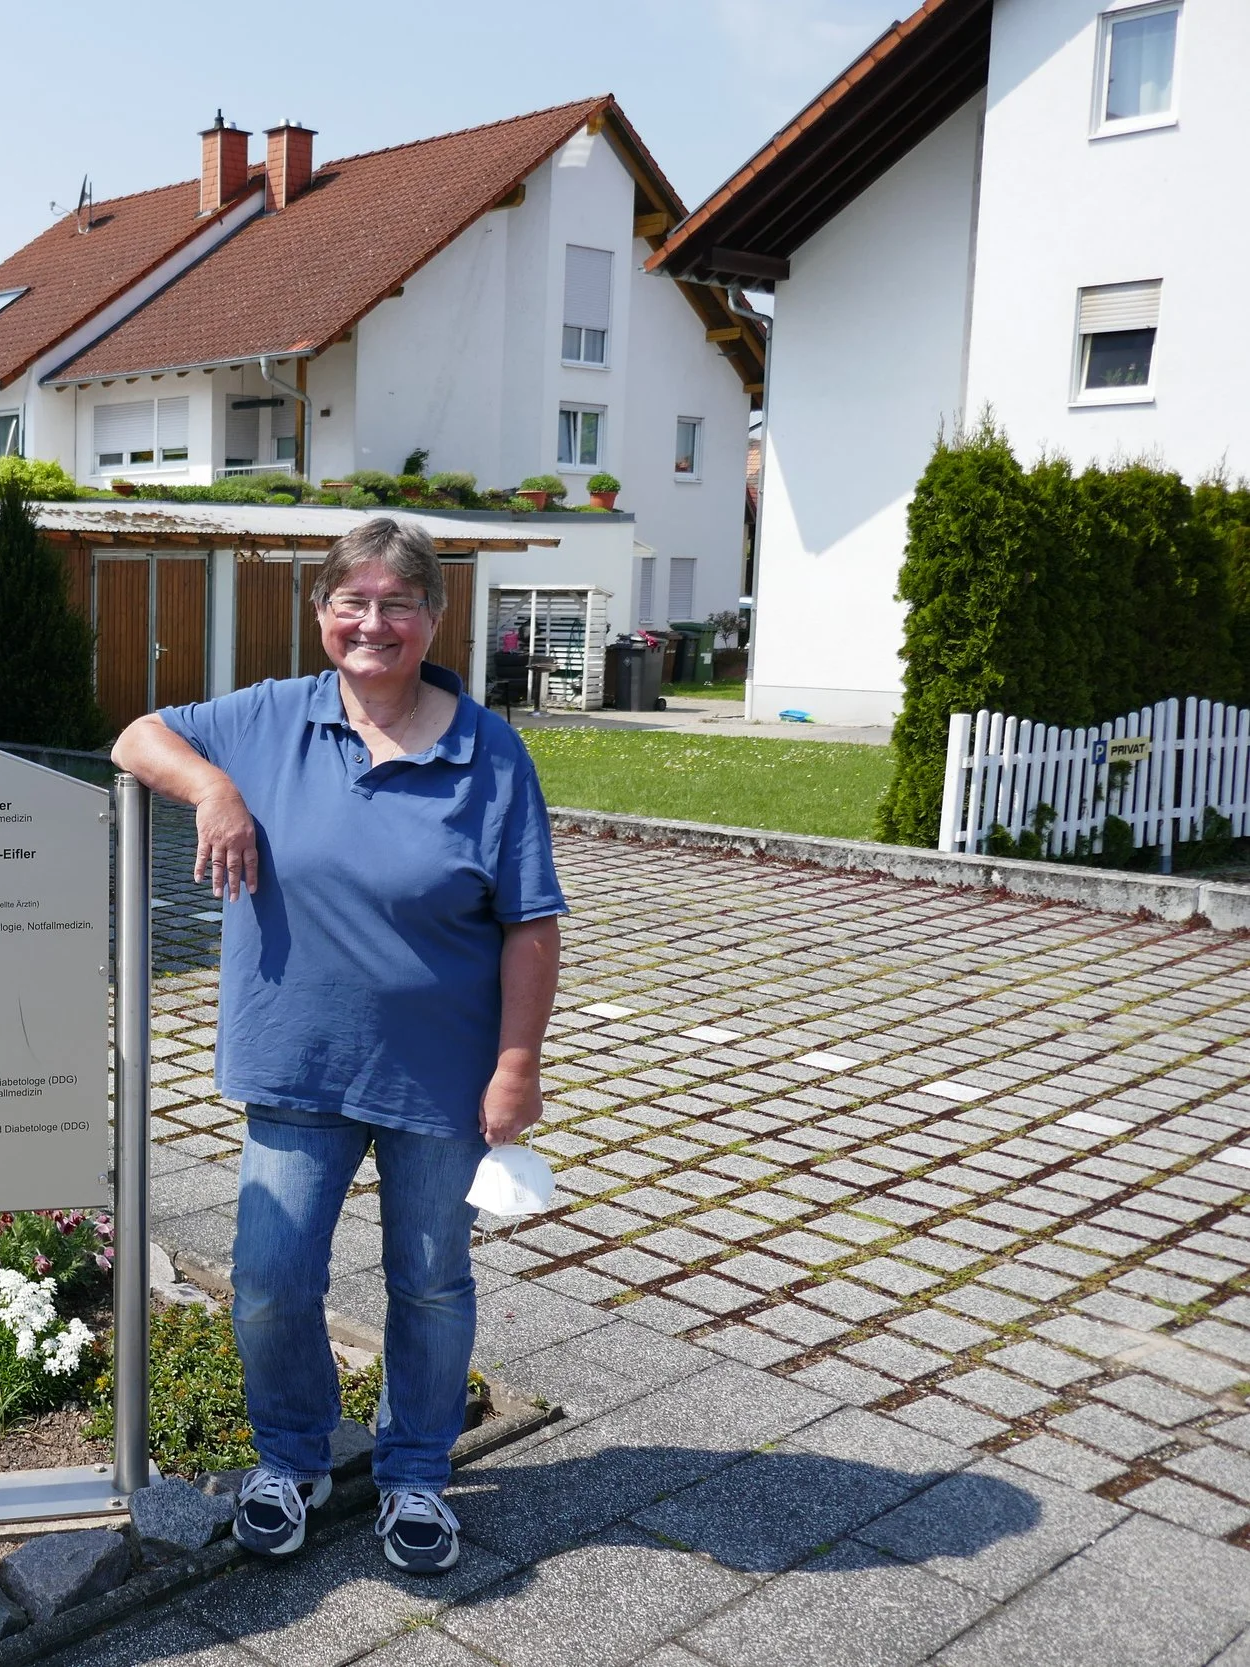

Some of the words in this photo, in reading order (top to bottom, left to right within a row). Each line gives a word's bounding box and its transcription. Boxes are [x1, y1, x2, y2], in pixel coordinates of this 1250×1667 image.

[1111, 743, 1145, 756] PRIVAT
[16, 900, 40, 910] Ärztin)
[28, 920, 94, 931] Notfallmedizin,
[49, 1075, 78, 1086] (DDG)
[4, 1122, 58, 1134] Diabetologe
[61, 1122, 90, 1132] (DDG)
